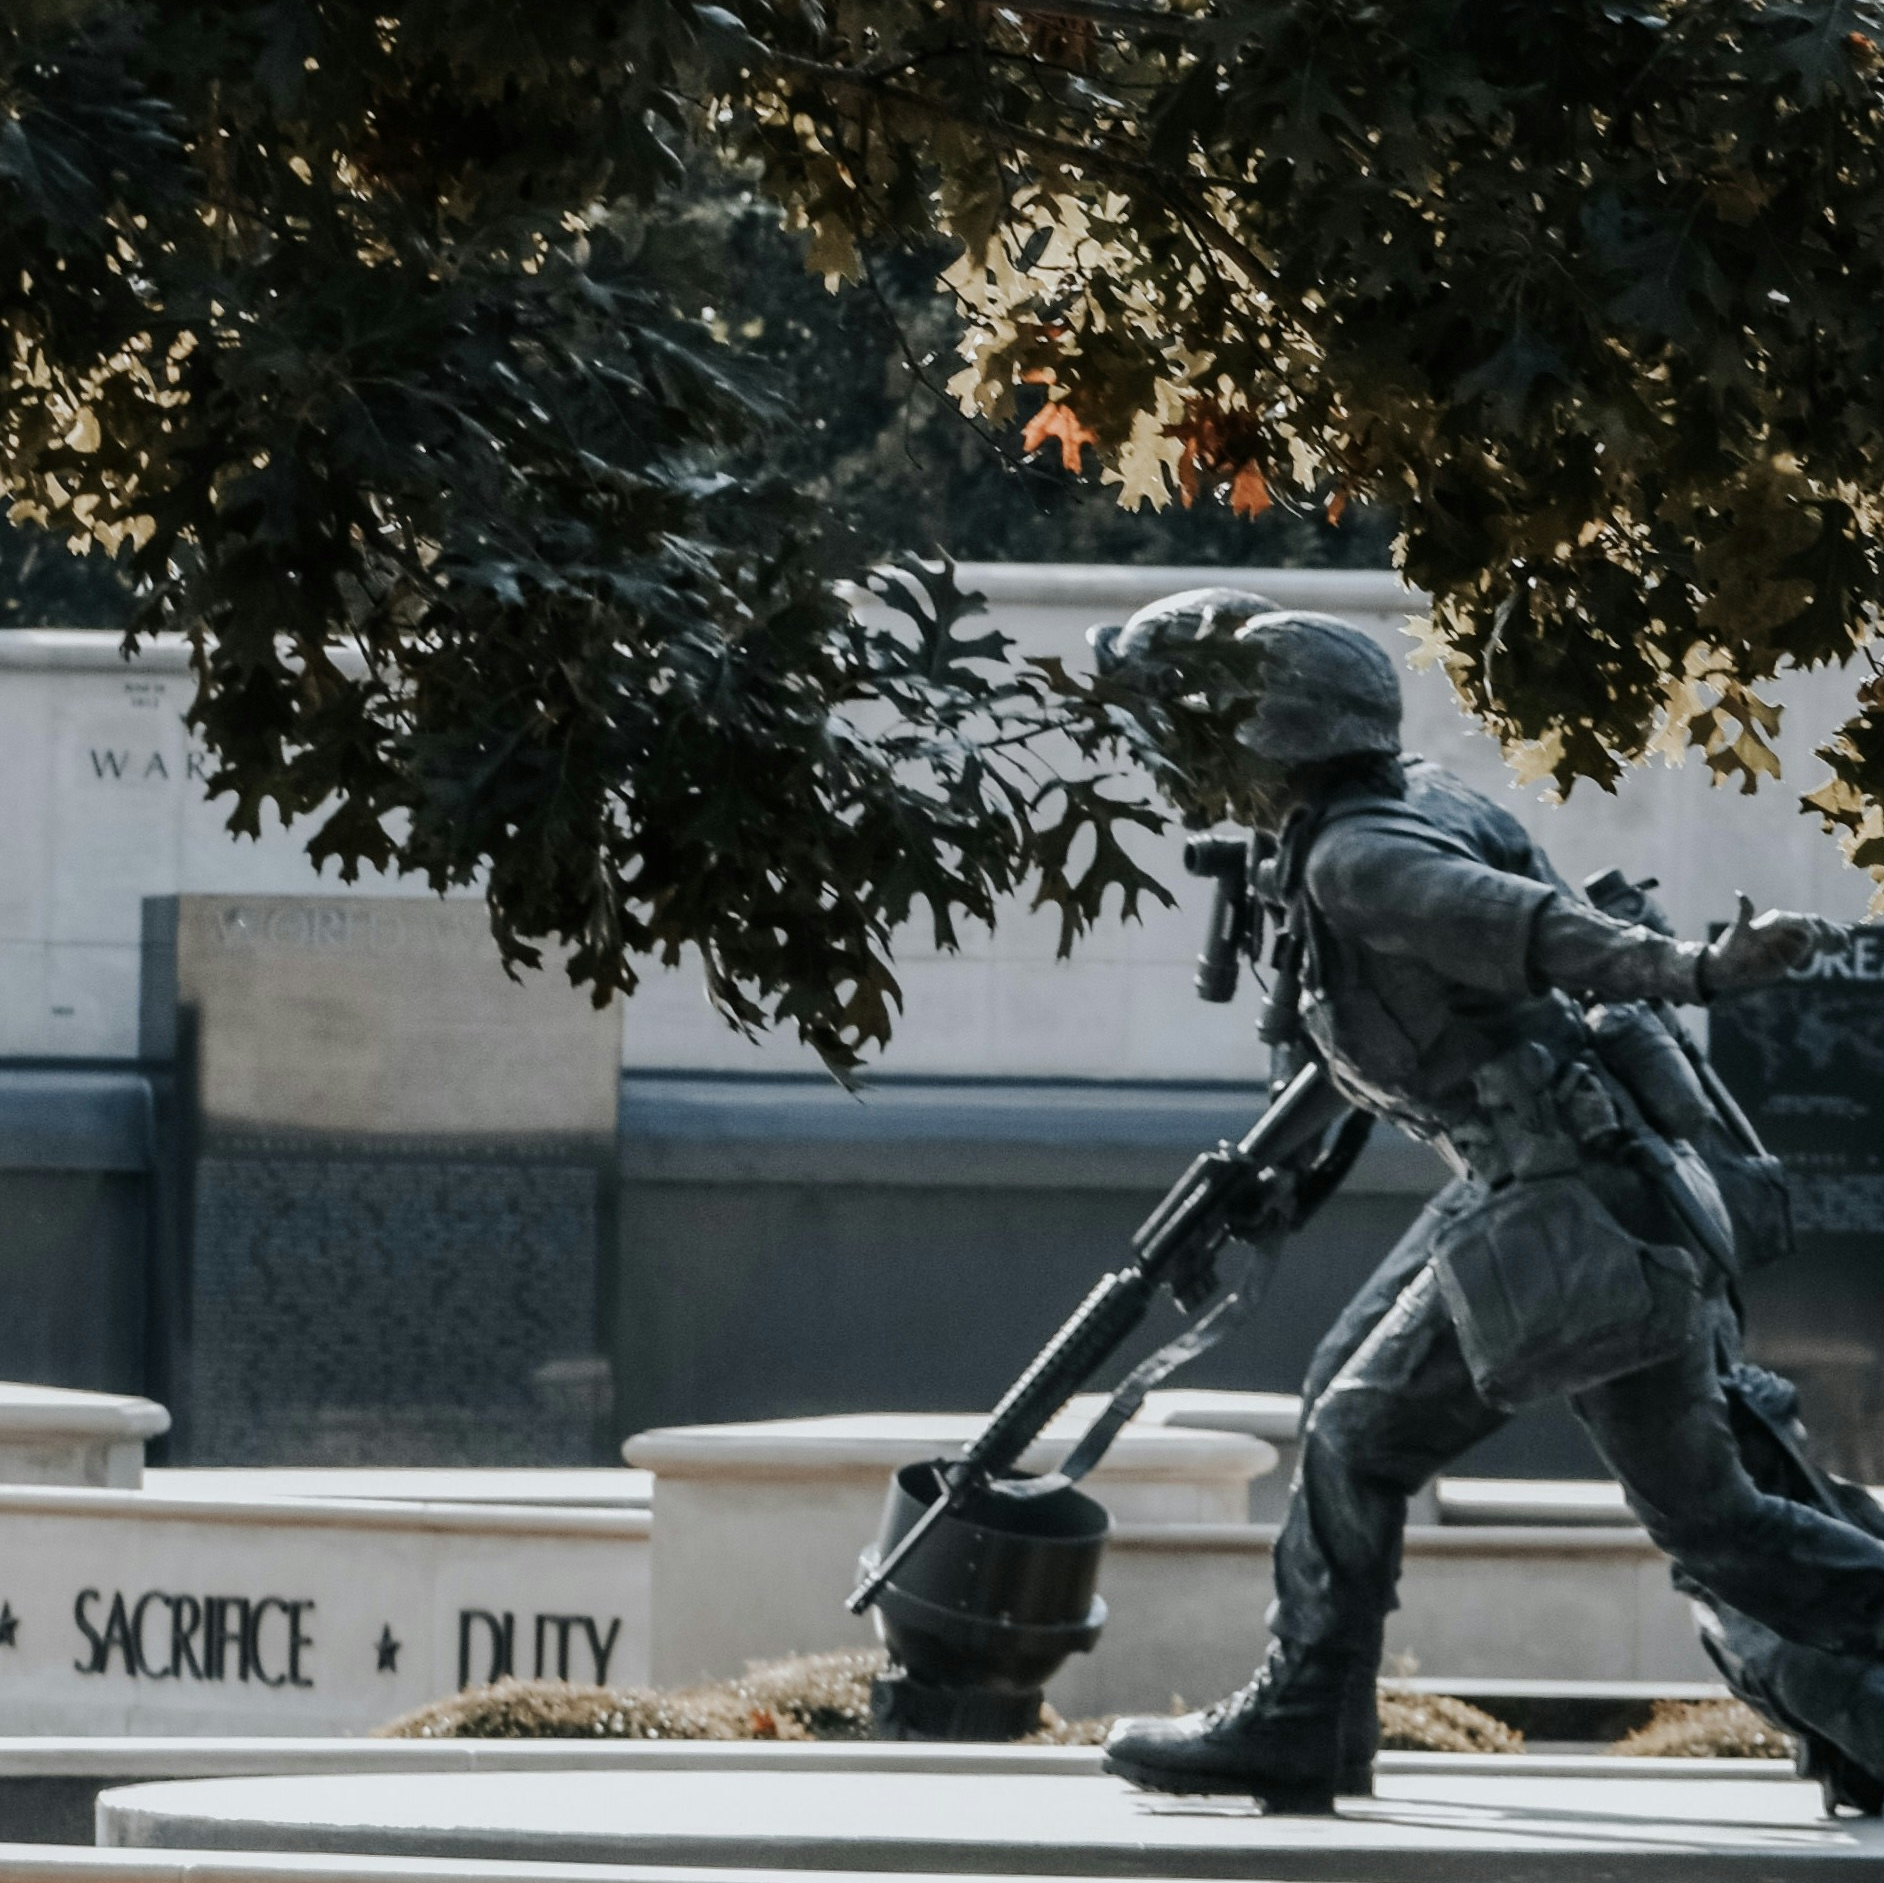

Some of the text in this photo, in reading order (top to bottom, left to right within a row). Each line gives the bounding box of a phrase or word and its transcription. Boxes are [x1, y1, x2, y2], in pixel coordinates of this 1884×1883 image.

[90, 749, 210, 779] WAR
[73, 1588, 621, 1693] SACRIFICE DUTY
